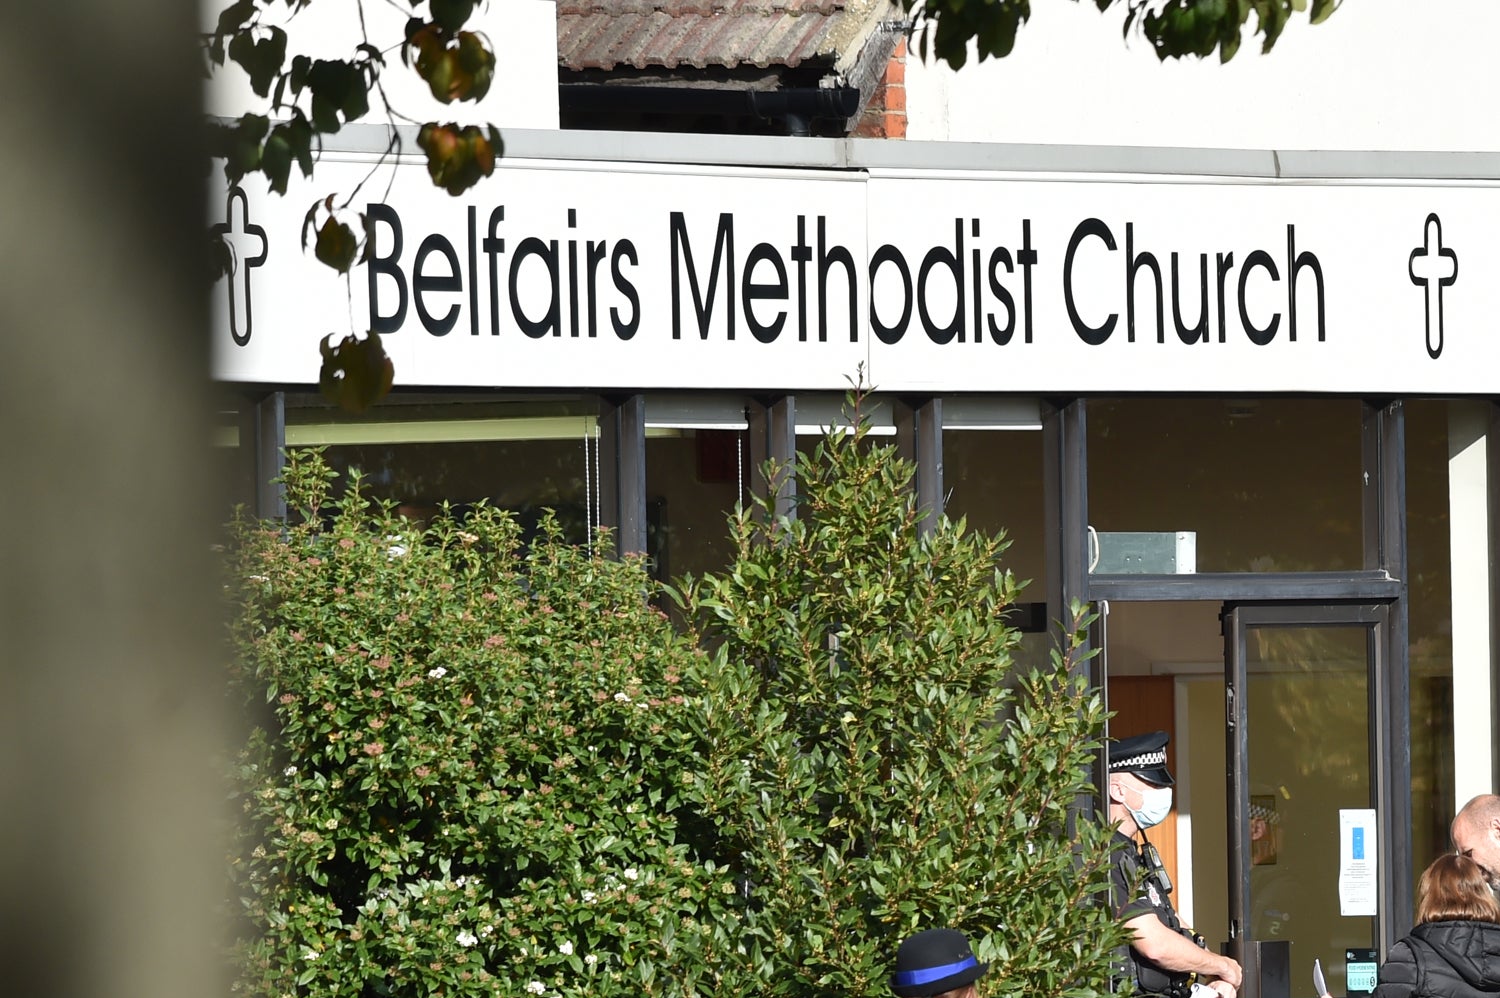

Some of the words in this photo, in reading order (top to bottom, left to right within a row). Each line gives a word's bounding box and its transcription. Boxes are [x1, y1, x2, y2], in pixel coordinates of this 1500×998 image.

[366, 202, 641, 342] Belfairs
[670, 211, 1038, 347] Methodist
[1063, 217, 1327, 347] Church
